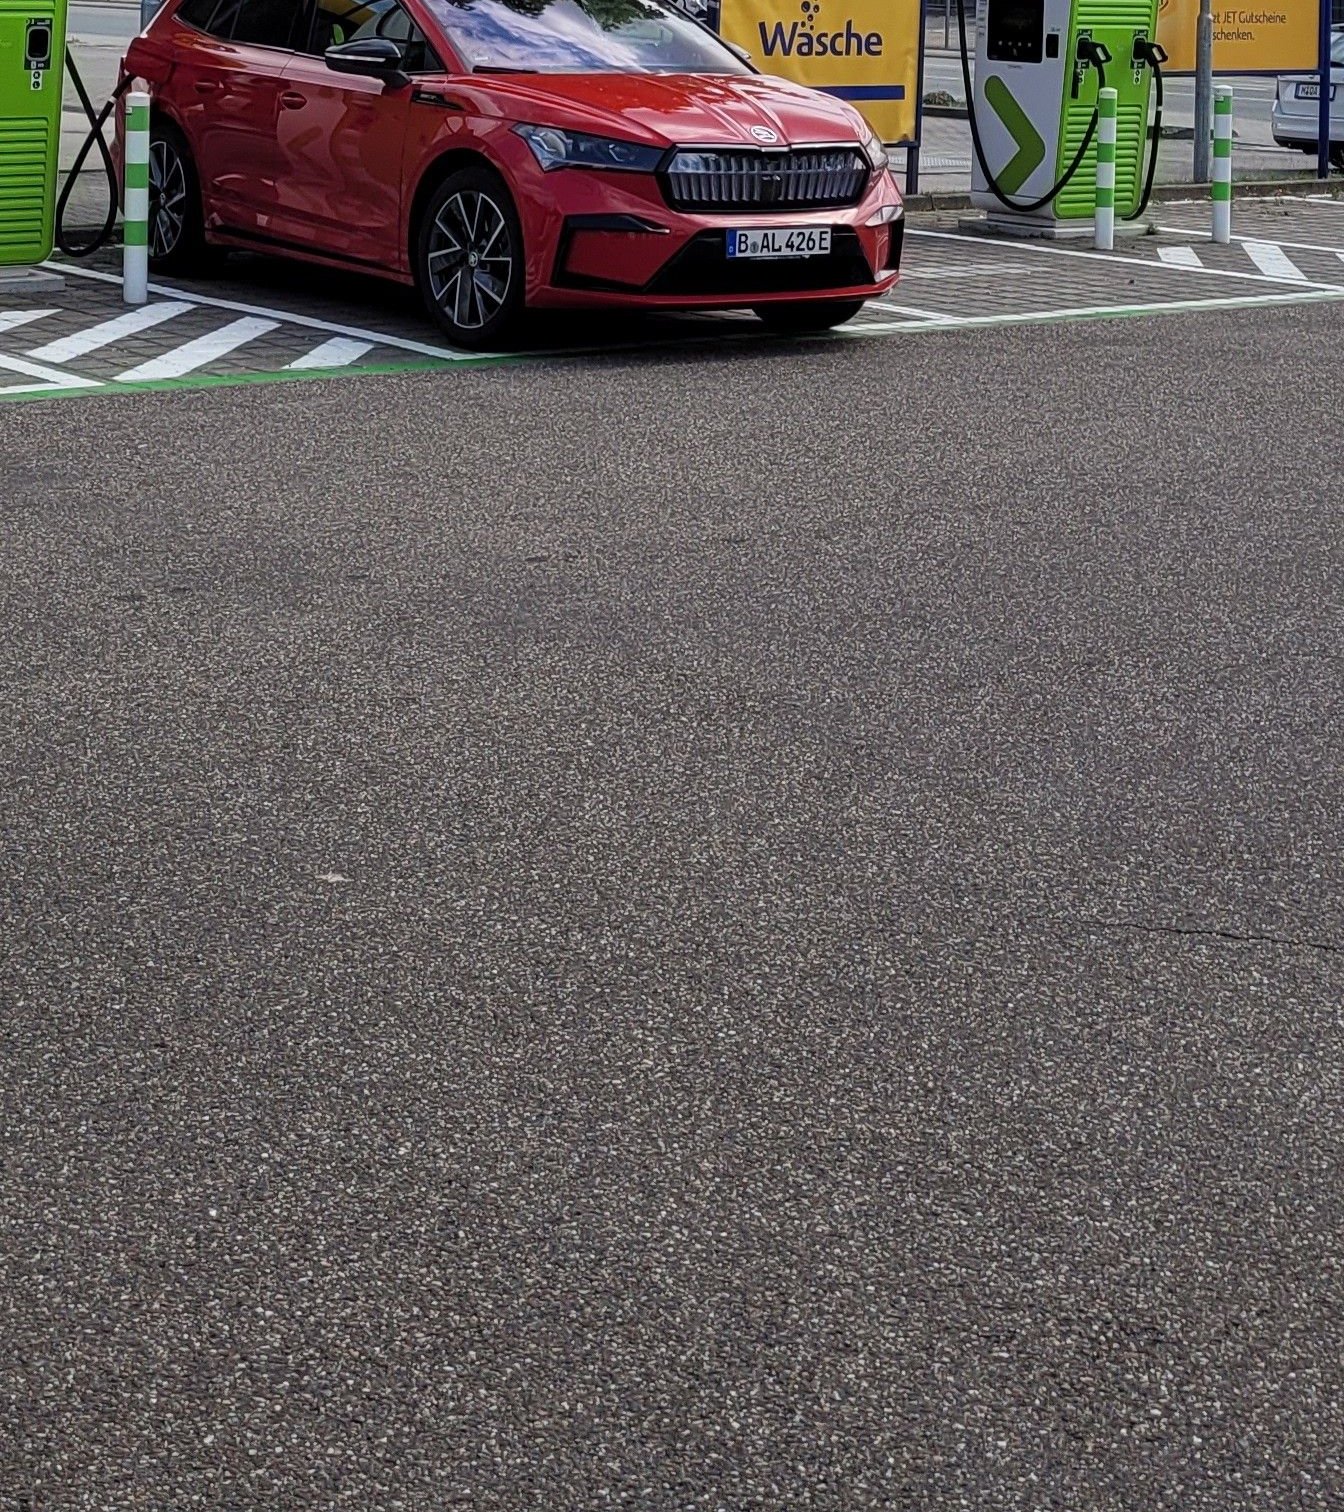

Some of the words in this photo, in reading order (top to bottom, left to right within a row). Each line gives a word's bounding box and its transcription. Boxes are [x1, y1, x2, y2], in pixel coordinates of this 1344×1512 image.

[1223, 12, 1236, 23] JET
[1239, 11, 1286, 24] Gutscheine
[1212, 28, 1255, 41] schenken.
[738, 233, 749, 253] B
[760, 233, 782, 253] AL
